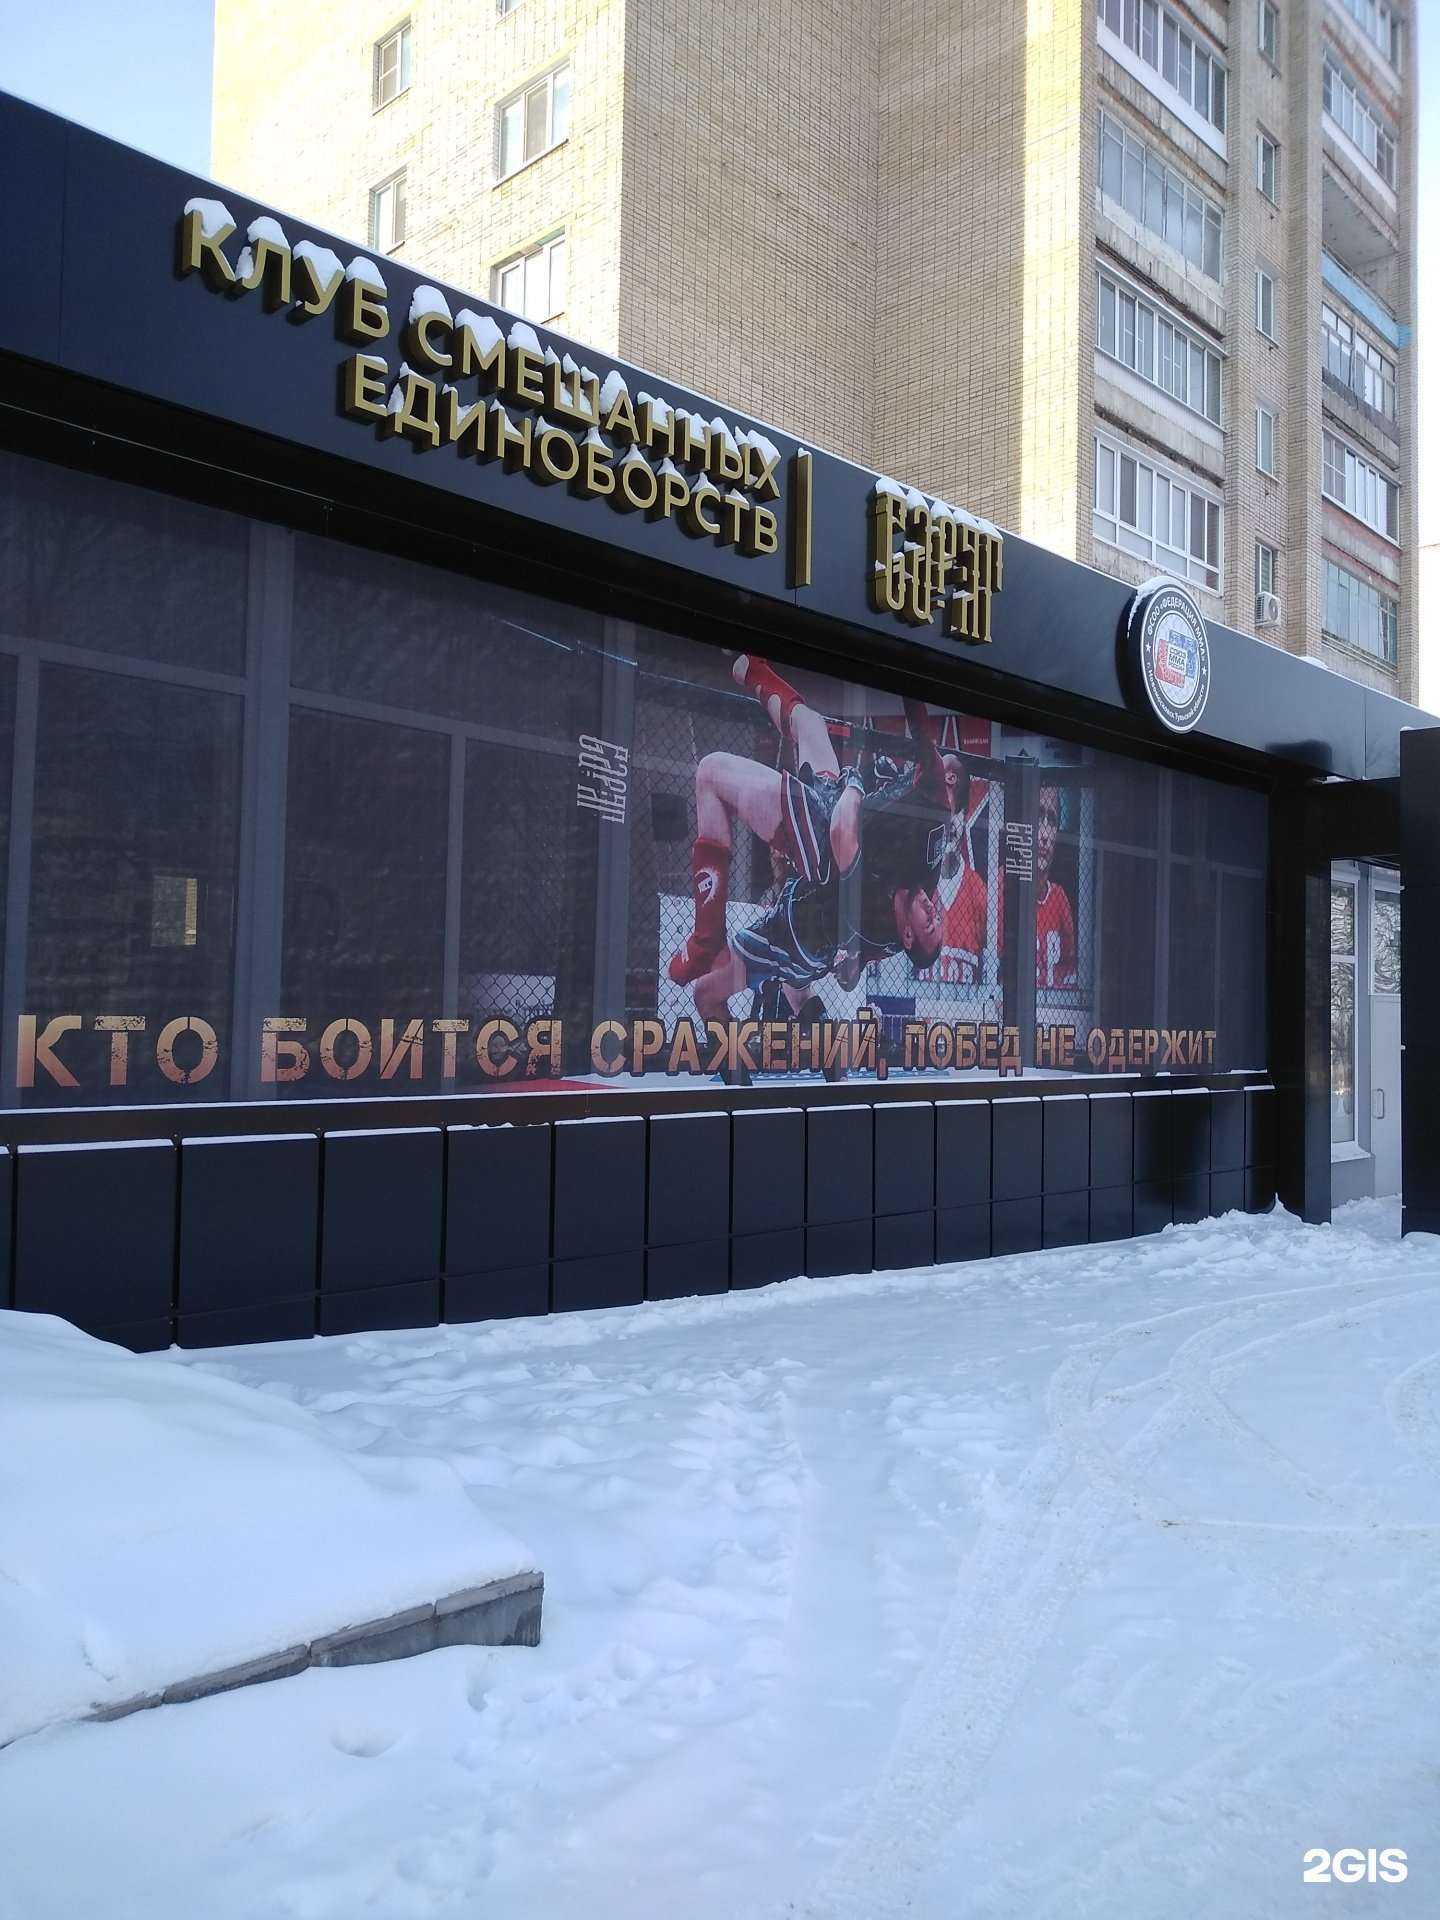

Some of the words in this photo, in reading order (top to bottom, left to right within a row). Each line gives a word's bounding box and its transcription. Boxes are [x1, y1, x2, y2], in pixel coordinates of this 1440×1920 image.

[182, 205, 390, 340] КЛУБ
[408, 308, 781, 500] СМЕШАННЫХ
[348, 353, 779, 555] ЕДИНОБОРСТВ
[16, 1014, 219, 1088] КТО
[261, 1017, 561, 1082] БОИТСЯ
[591, 1008, 888, 1079] СРАЖЕНИЙ,
[904, 1022, 1021, 1076] ПОБЕД
[1035, 1024, 1076, 1068] НЕ
[1087, 1027, 1218, 1072] ОДЕРЖИТ
